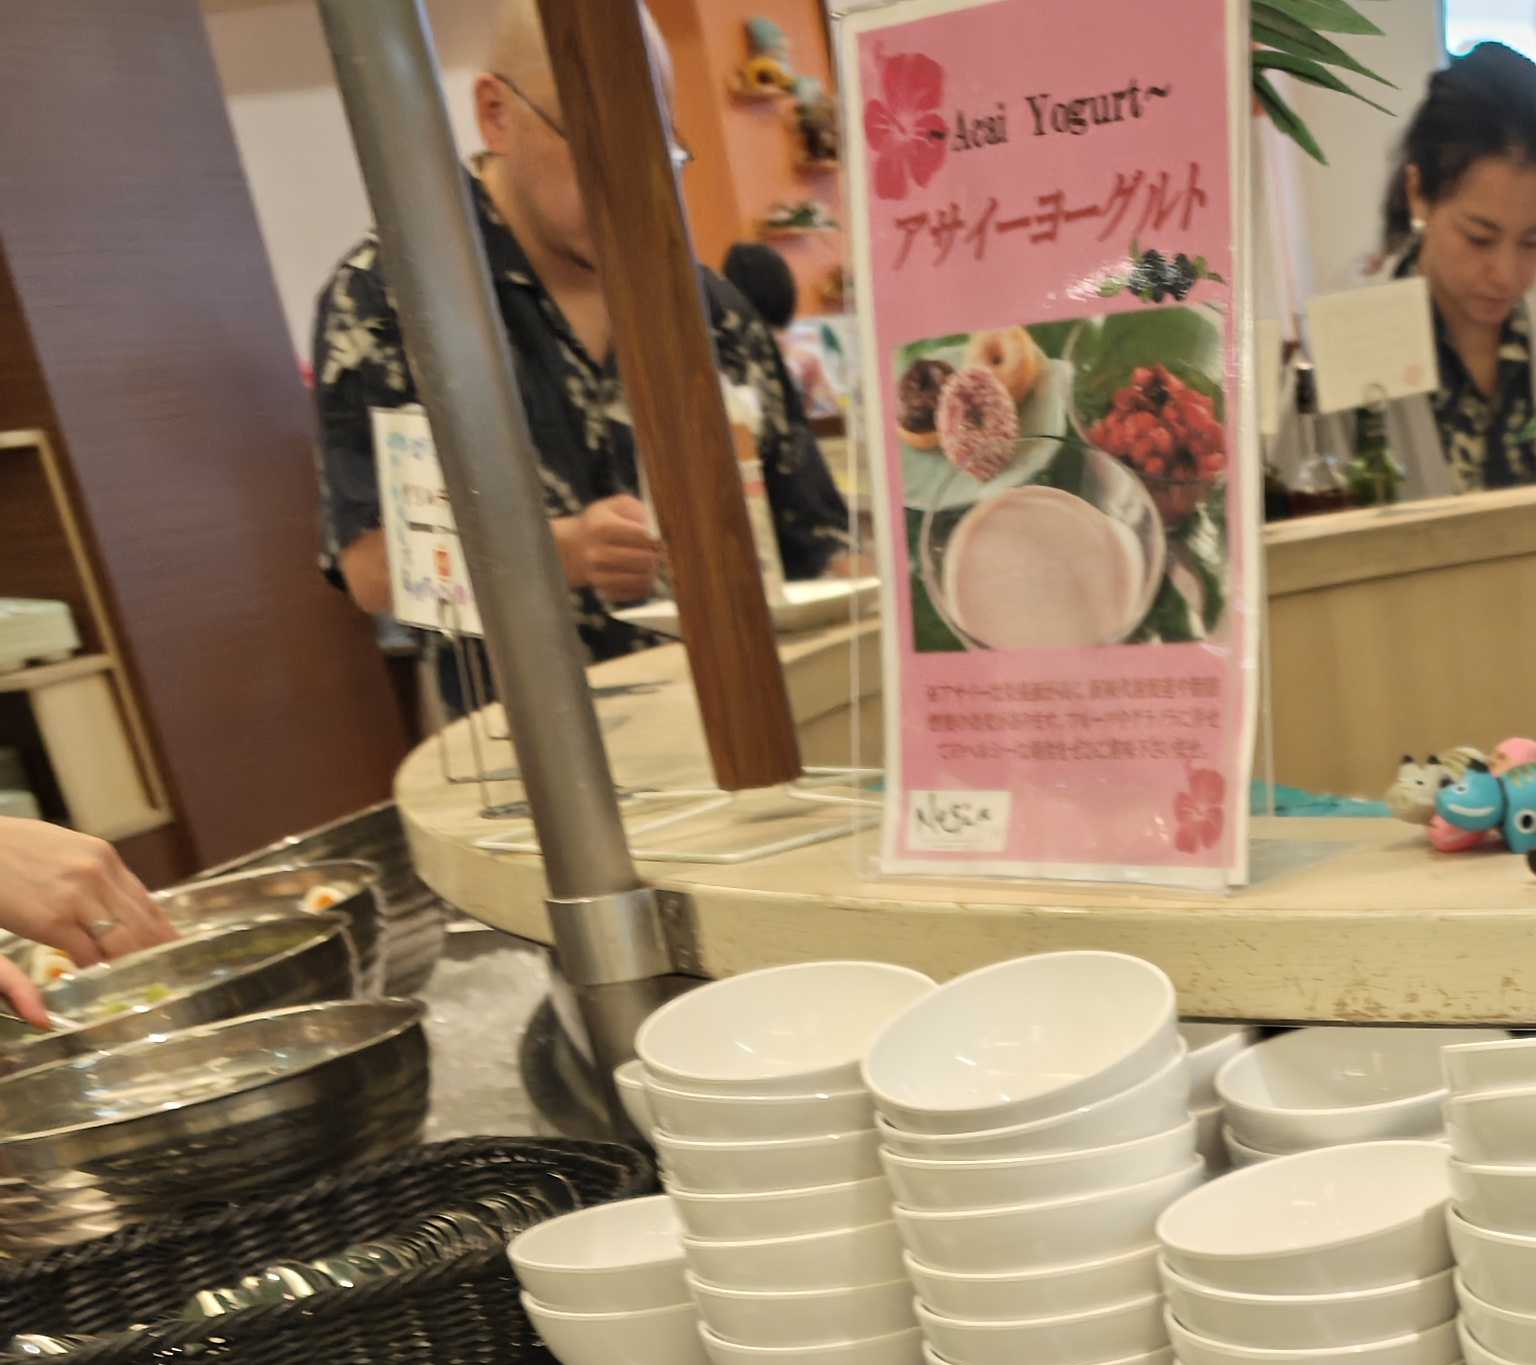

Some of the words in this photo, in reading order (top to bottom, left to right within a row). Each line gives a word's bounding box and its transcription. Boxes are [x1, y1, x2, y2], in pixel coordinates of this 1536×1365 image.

[892, 161, 1208, 270] アサイーヨーグルト
